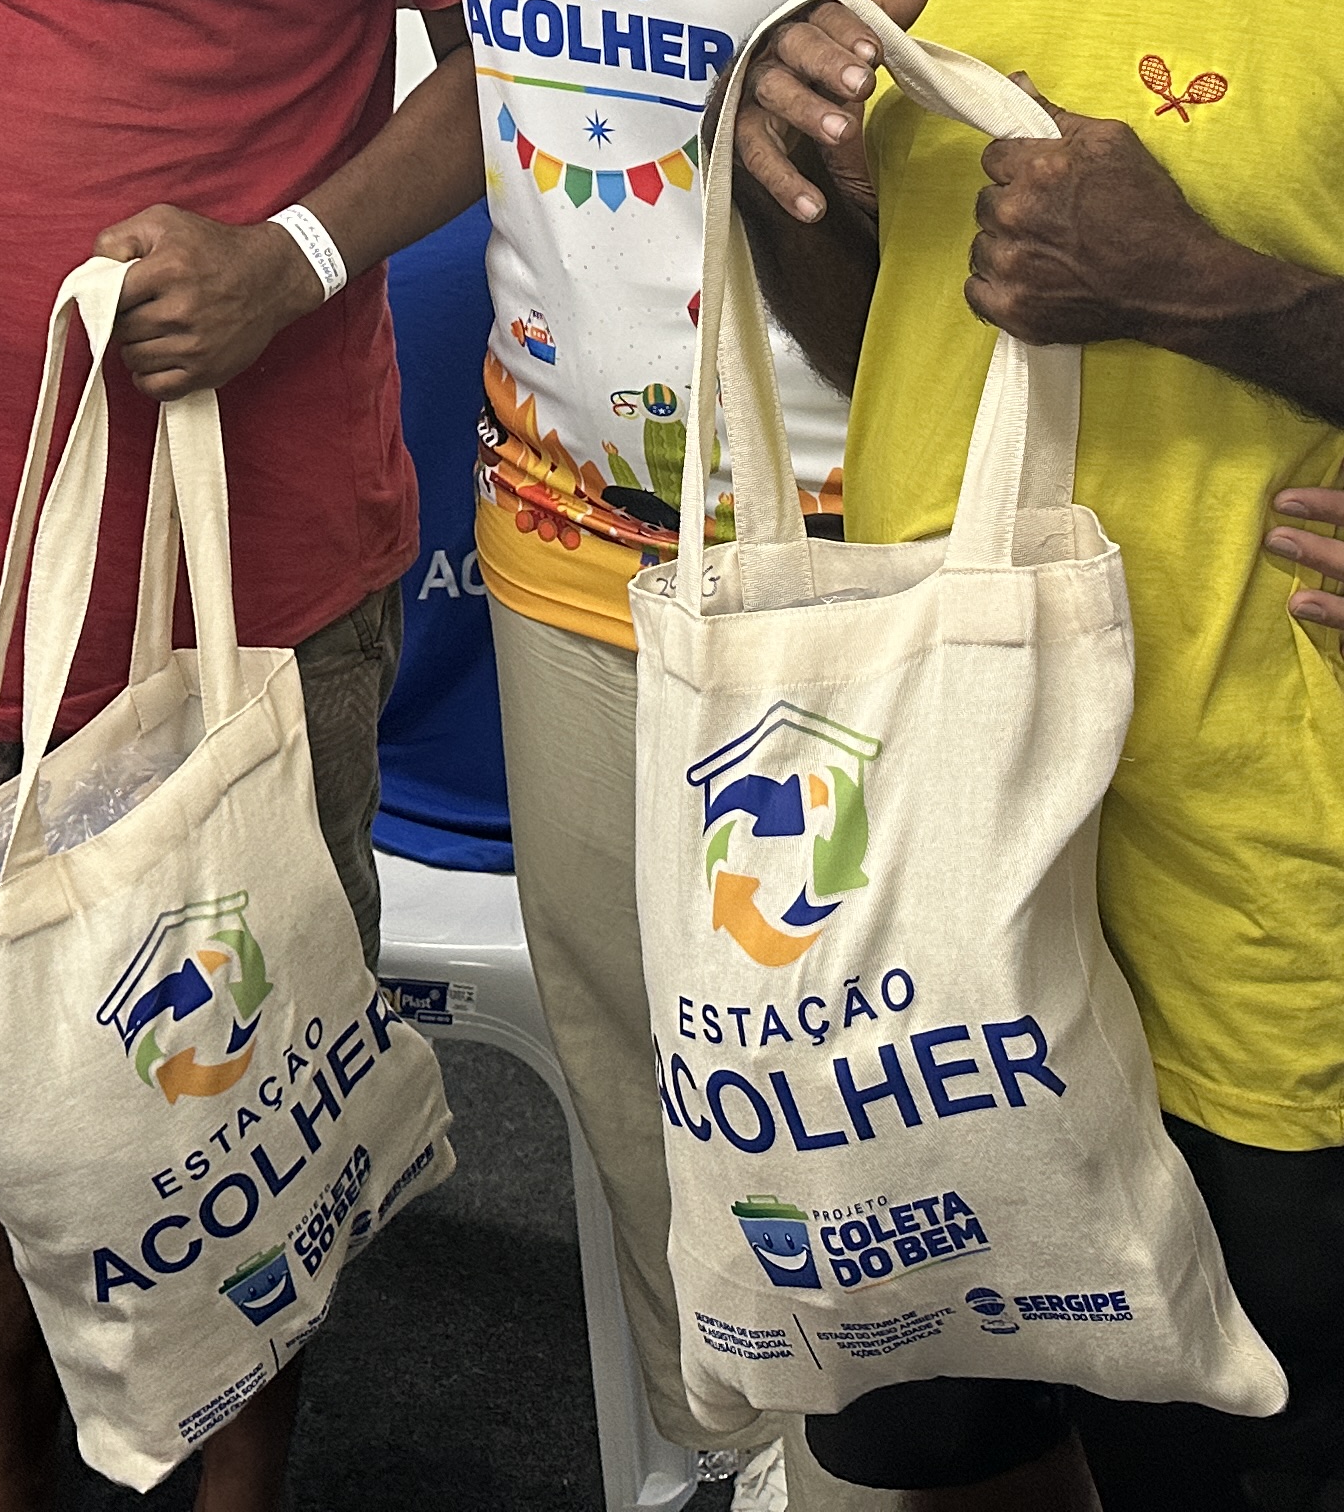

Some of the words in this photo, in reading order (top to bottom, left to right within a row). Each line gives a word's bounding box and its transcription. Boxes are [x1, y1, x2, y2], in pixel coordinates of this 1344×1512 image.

[679, 968, 915, 1046] ESTAÇÃO
[151, 1017, 323, 1200] ESTAÇÃO
[654, 1014, 1067, 1154] ACOLHER
[294, 1144, 370, 1257] COLETA
[812, 1194, 888, 1222] PROJETO
[820, 1190, 976, 1257] COLETA
[303, 1223, 335, 1278] DO
[829, 1246, 894, 1288] DO
[892, 1217, 989, 1268] BEM
[901, 1310, 918, 1321] DE
[1013, 1290, 1131, 1314] SERGIPE
[1022, 1312, 1071, 1322] GOVERNO
[1073, 1313, 1089, 1322] DO
[1090, 1311, 1134, 1323] ESTADO
